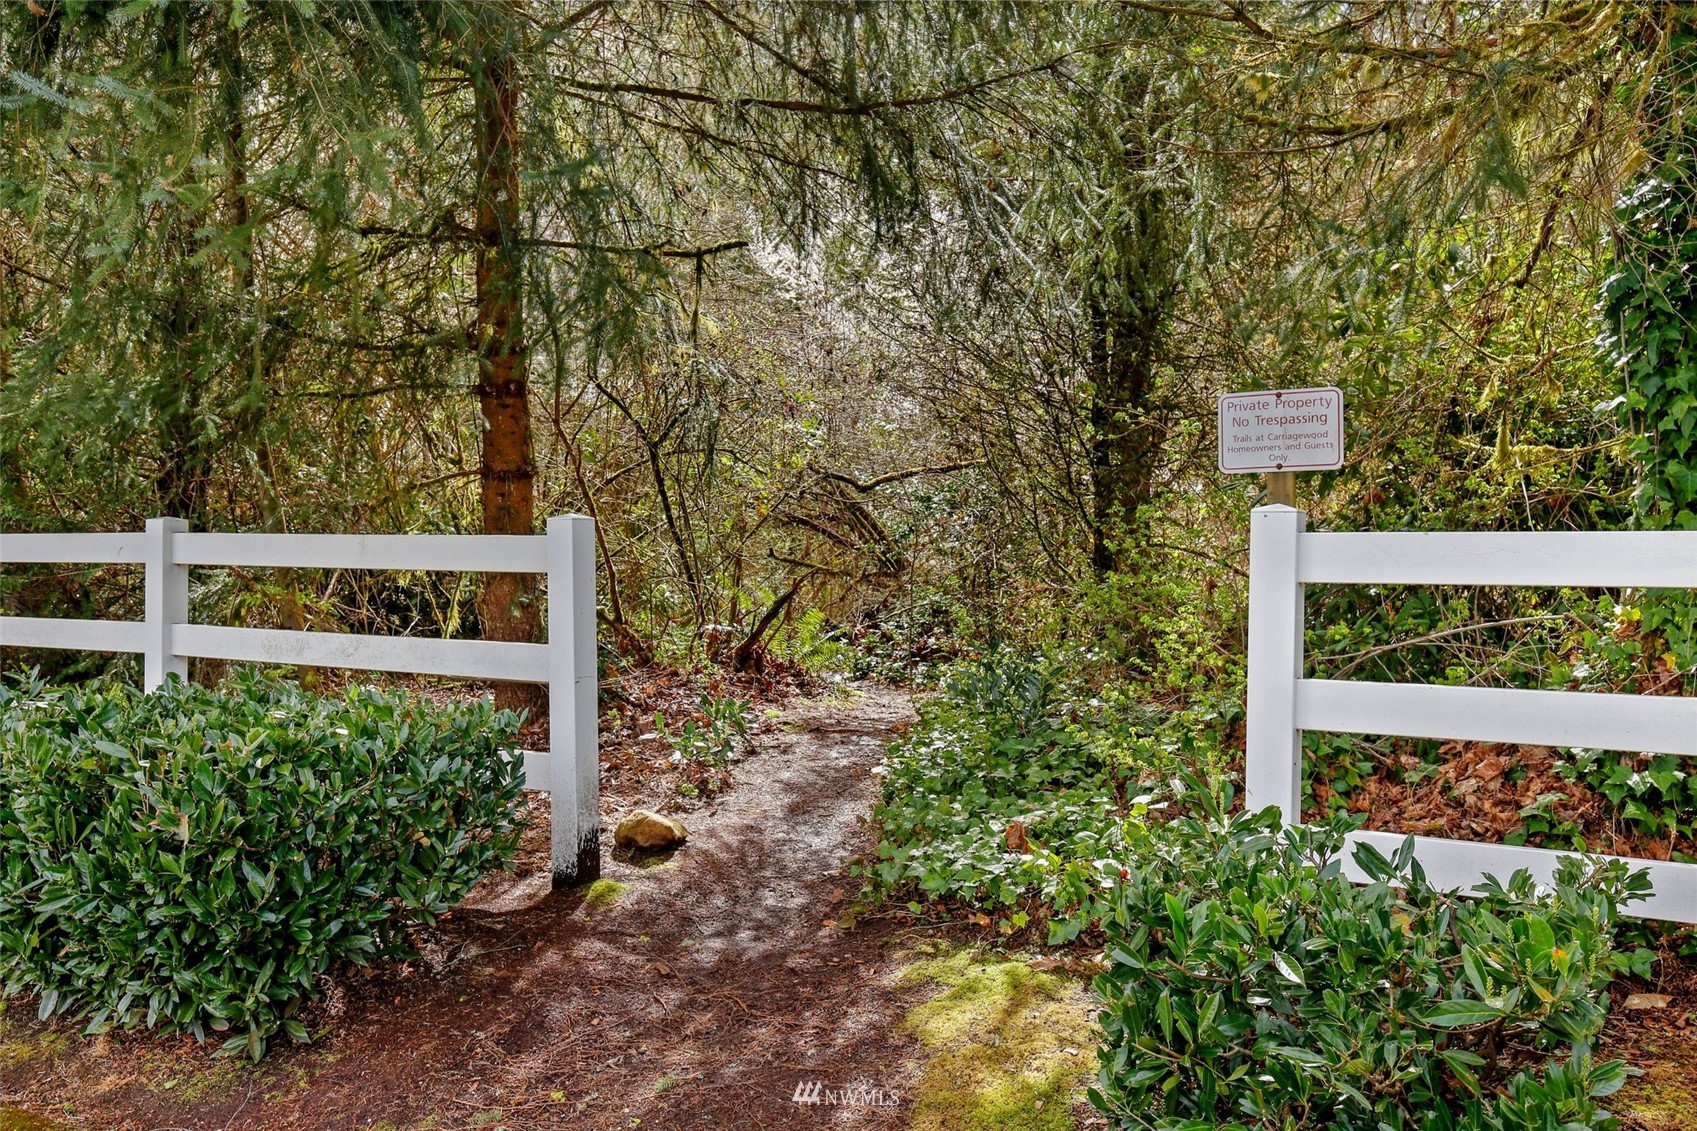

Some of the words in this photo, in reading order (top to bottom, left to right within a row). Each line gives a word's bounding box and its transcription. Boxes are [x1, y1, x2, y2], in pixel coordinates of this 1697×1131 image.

[1227, 400, 1270, 412] Private
[1275, 396, 1333, 410] Property
[1232, 417, 1250, 427] No
[1255, 411, 1328, 427] Trespassing
[1233, 434, 1253, 443] Trails
[1267, 430, 1329, 442] Carriagewood
[1227, 443, 1282, 453] Homeowners
[1284, 442, 1301, 451] and
[1304, 441, 1334, 450] Guests
[1268, 453, 1291, 463] Only.
